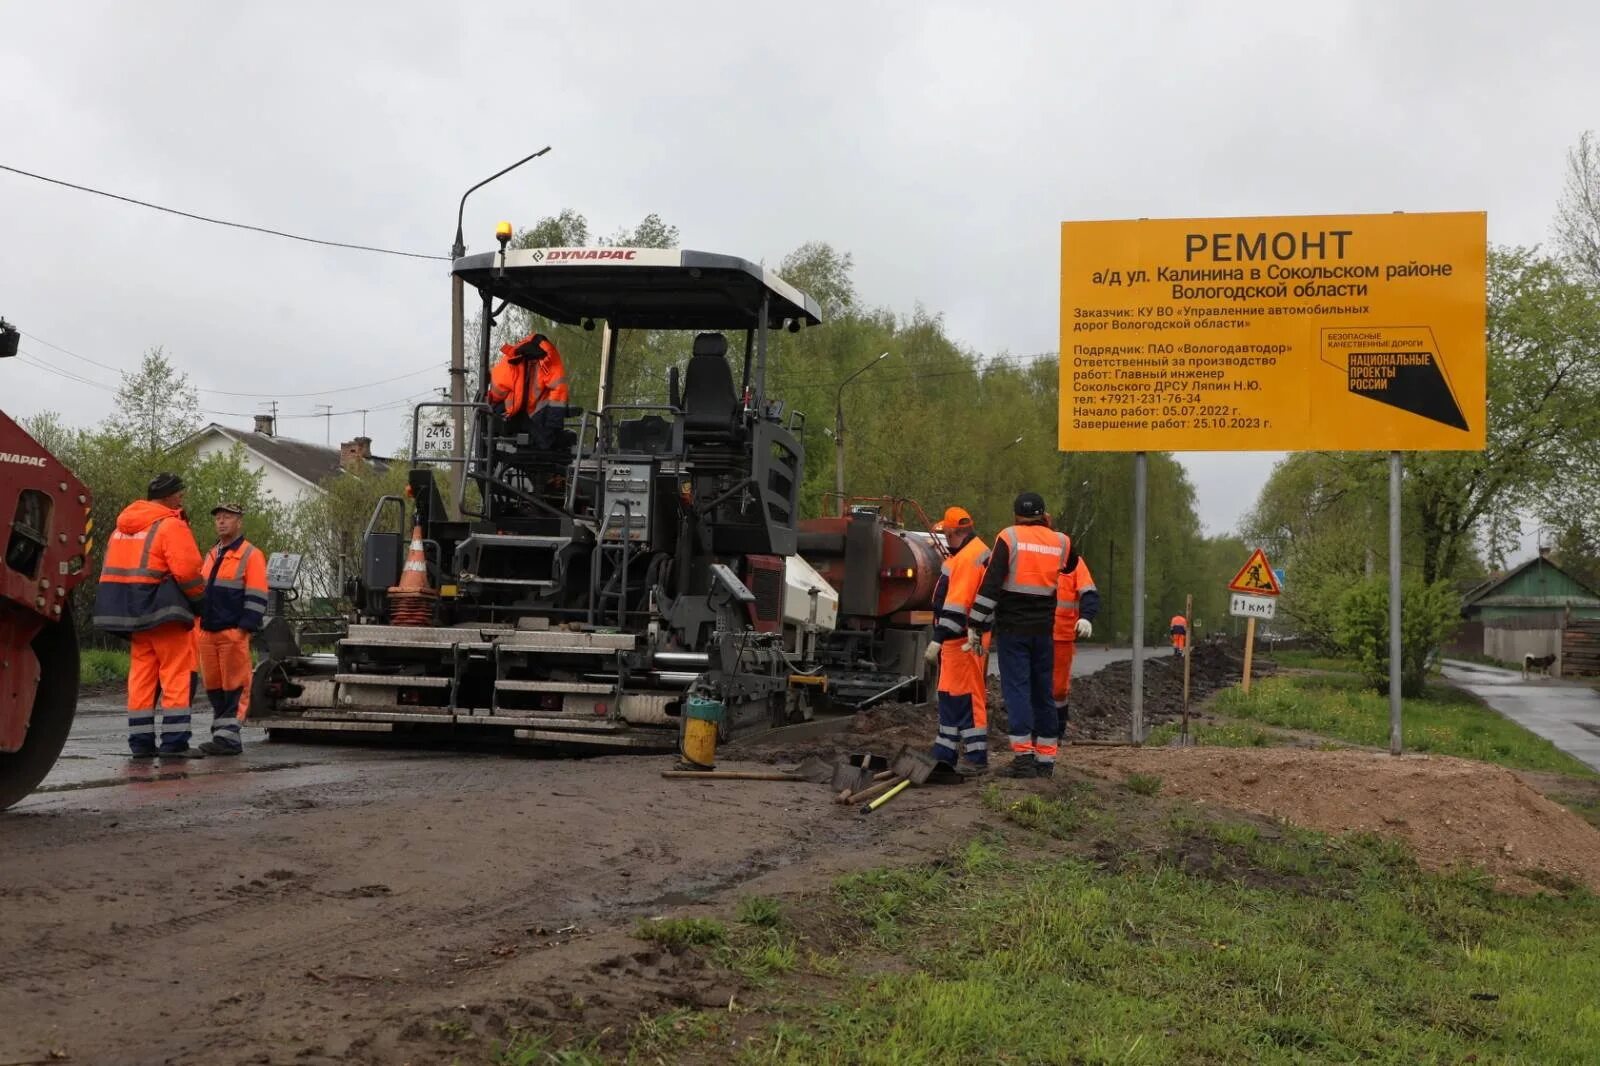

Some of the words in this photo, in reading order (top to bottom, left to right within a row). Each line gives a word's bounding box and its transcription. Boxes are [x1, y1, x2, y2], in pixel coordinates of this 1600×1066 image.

[1186, 231, 1353, 262] РЕМОНТ
[546, 250, 636, 260] DYNAPAC
[1092, 268, 1121, 286] а/д
[1127, 270, 1150, 287] ул.
[1157, 267, 1244, 282] Калинина
[1251, 268, 1260, 280] в
[1268, 264, 1379, 279] Сокольском
[1387, 261, 1452, 281] районе
[1172, 282, 1287, 301] Вологодской
[1293, 282, 1367, 297] области
[1074, 308, 1134, 318] Заказчик:
[1138, 307, 1153, 316] КУ
[1157, 307, 1173, 316] ВО
[1177, 306, 1264, 318] «Управленние
[1268, 304, 1369, 315] автомобильных
[1073, 321, 1107, 332] дорог
[1112, 319, 1190, 330] Вологодской
[1194, 319, 1250, 329] области»
[1074, 345, 1144, 356] Подрядчик:
[1149, 344, 1174, 354] ПАО
[1178, 344, 1293, 354] «Вологодавтодор»
[1392, 340, 1423, 348] ДОРОГИ
[1074, 357, 1168, 367] Ответственный
[1189, 357, 1276, 368] производство
[1350, 354, 1431, 366] НАЦИОНАЛЬНЫЕ
[1074, 371, 1111, 381] работ:
[1115, 369, 1167, 379] Главный
[1171, 370, 1224, 380] инженер
[1350, 366, 1396, 378] ПРОЕКТЫ
[1074, 383, 1150, 392] Сокольского
[1154, 382, 1188, 393] ДРСУ
[1192, 383, 1230, 391] Ляпин
[1234, 381, 1262, 391] Н.Ю.
[1350, 379, 1387, 389] РОССИИ
[1074, 396, 1096, 404] тел:
[1100, 394, 1201, 404] +7921-231-76-34
[1074, 408, 1117, 417] Начало
[1121, 407, 1158, 418] работ:
[1162, 406, 1229, 416] 05.07.2022
[1233, 408, 1240, 416] г.
[1074, 420, 1147, 430] Завершение
[1151, 420, 1189, 430] работ:
[1194, 419, 1260, 428] 25.10.2023
[426, 428, 451, 438] 2416
[424, 442, 436, 450] ВК
[442, 442, 452, 450] 35
[1241, 600, 1245, 610] 1
